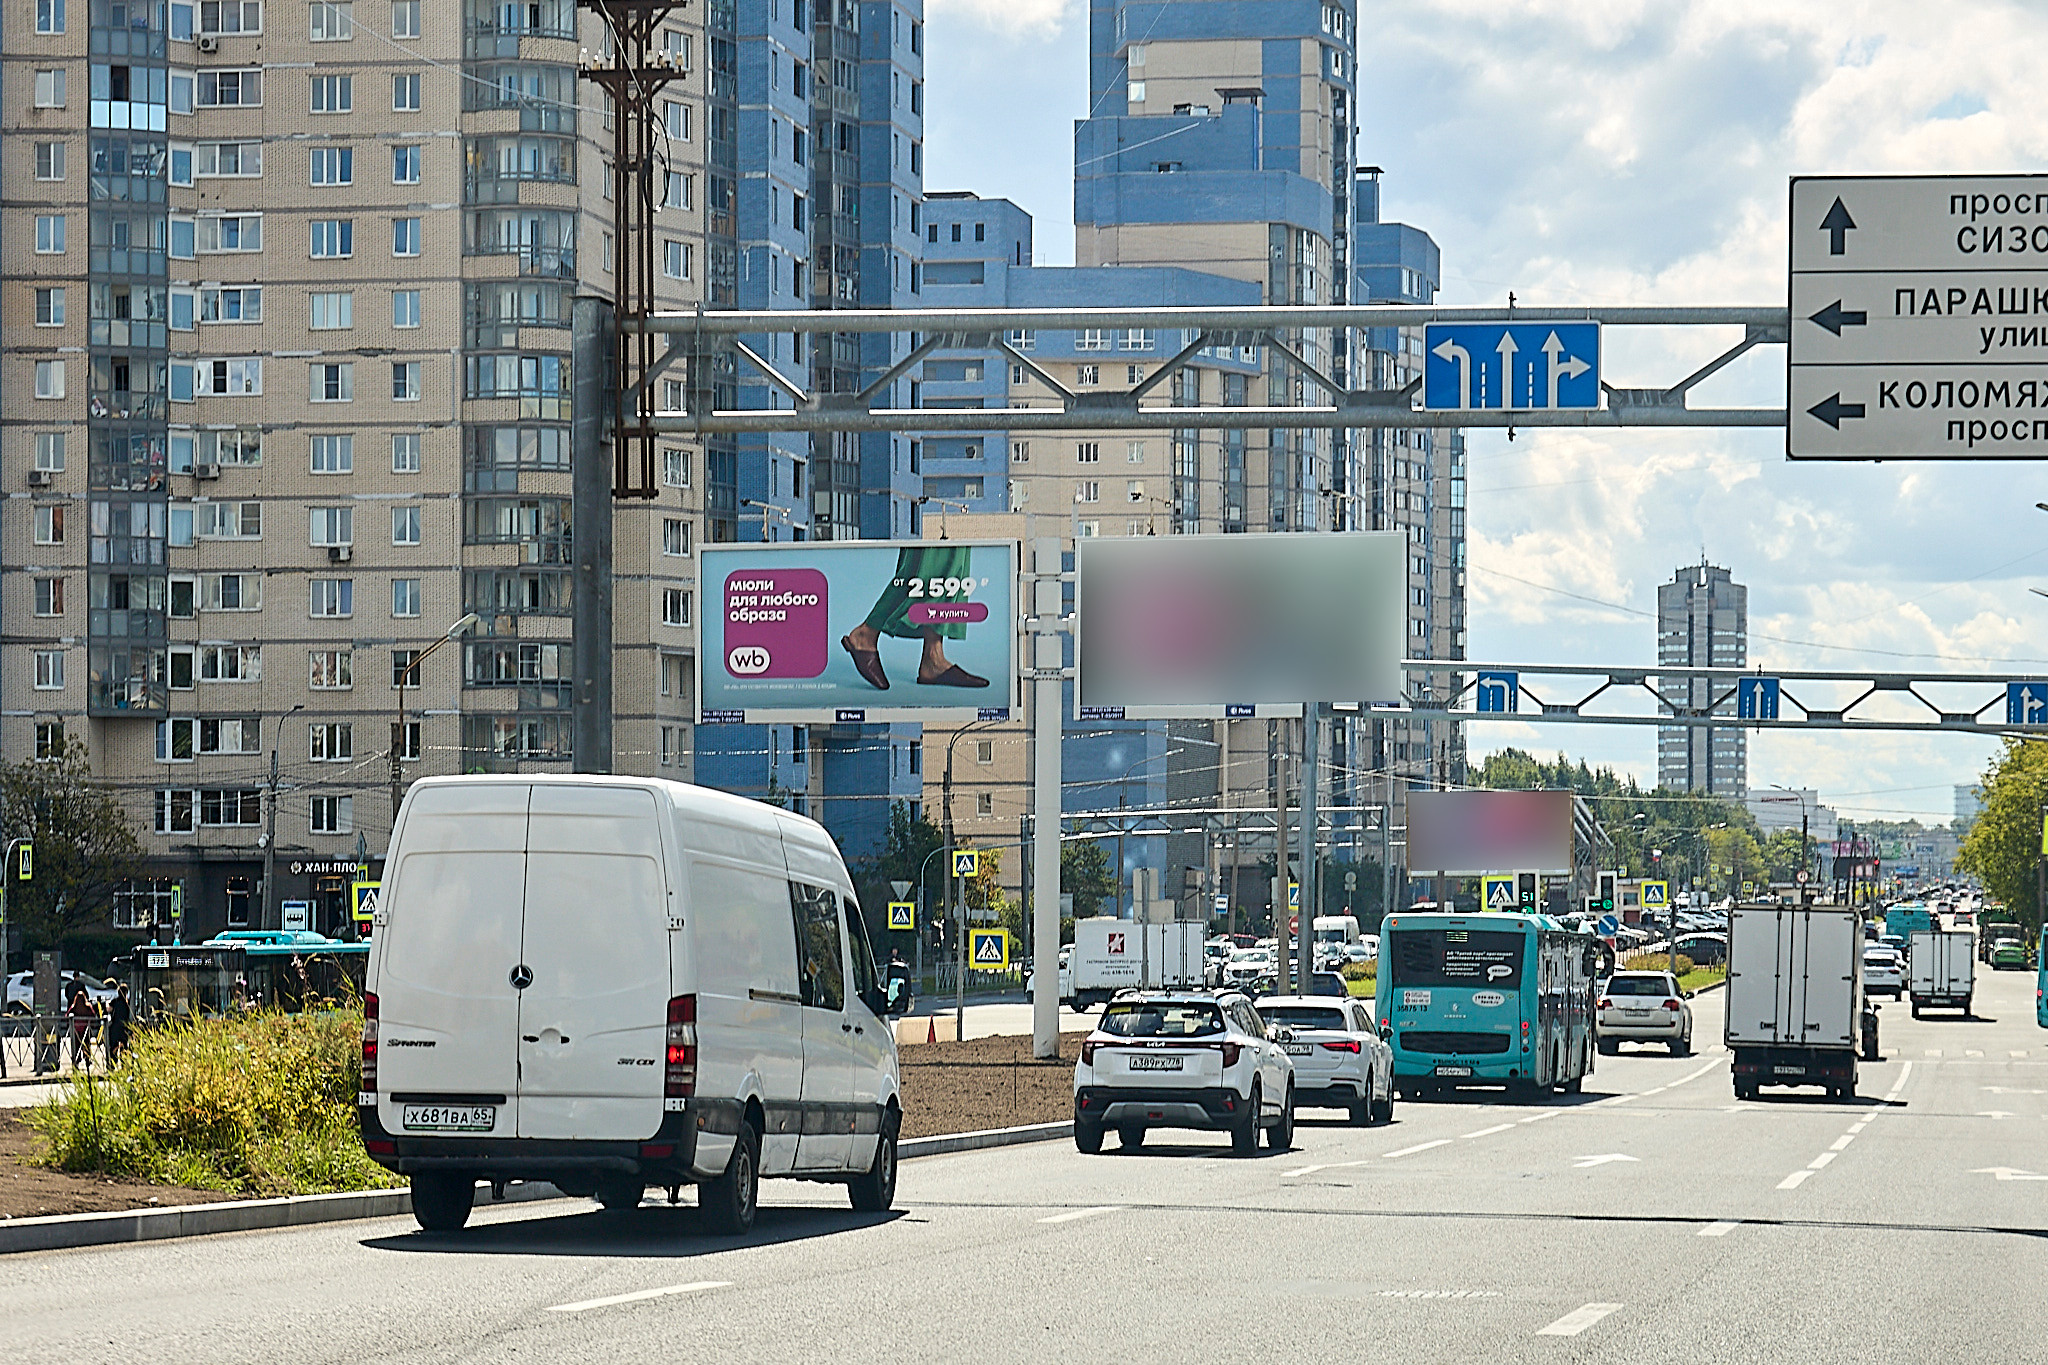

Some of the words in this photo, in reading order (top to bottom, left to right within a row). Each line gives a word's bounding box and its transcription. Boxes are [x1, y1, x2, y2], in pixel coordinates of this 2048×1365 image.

[1957, 226, 2048, 254] СИЗО
[1879, 380, 2048, 409] КОЛОМЯ
[730, 580, 774, 591] мюли
[893, 578, 905, 587] от
[730, 595, 757, 607] для
[760, 591, 819, 606] любого
[729, 607, 787, 624] образа
[939, 608, 969, 620] купить
[734, 650, 765, 668] wb
[473, 1108, 488, 1121] 65
